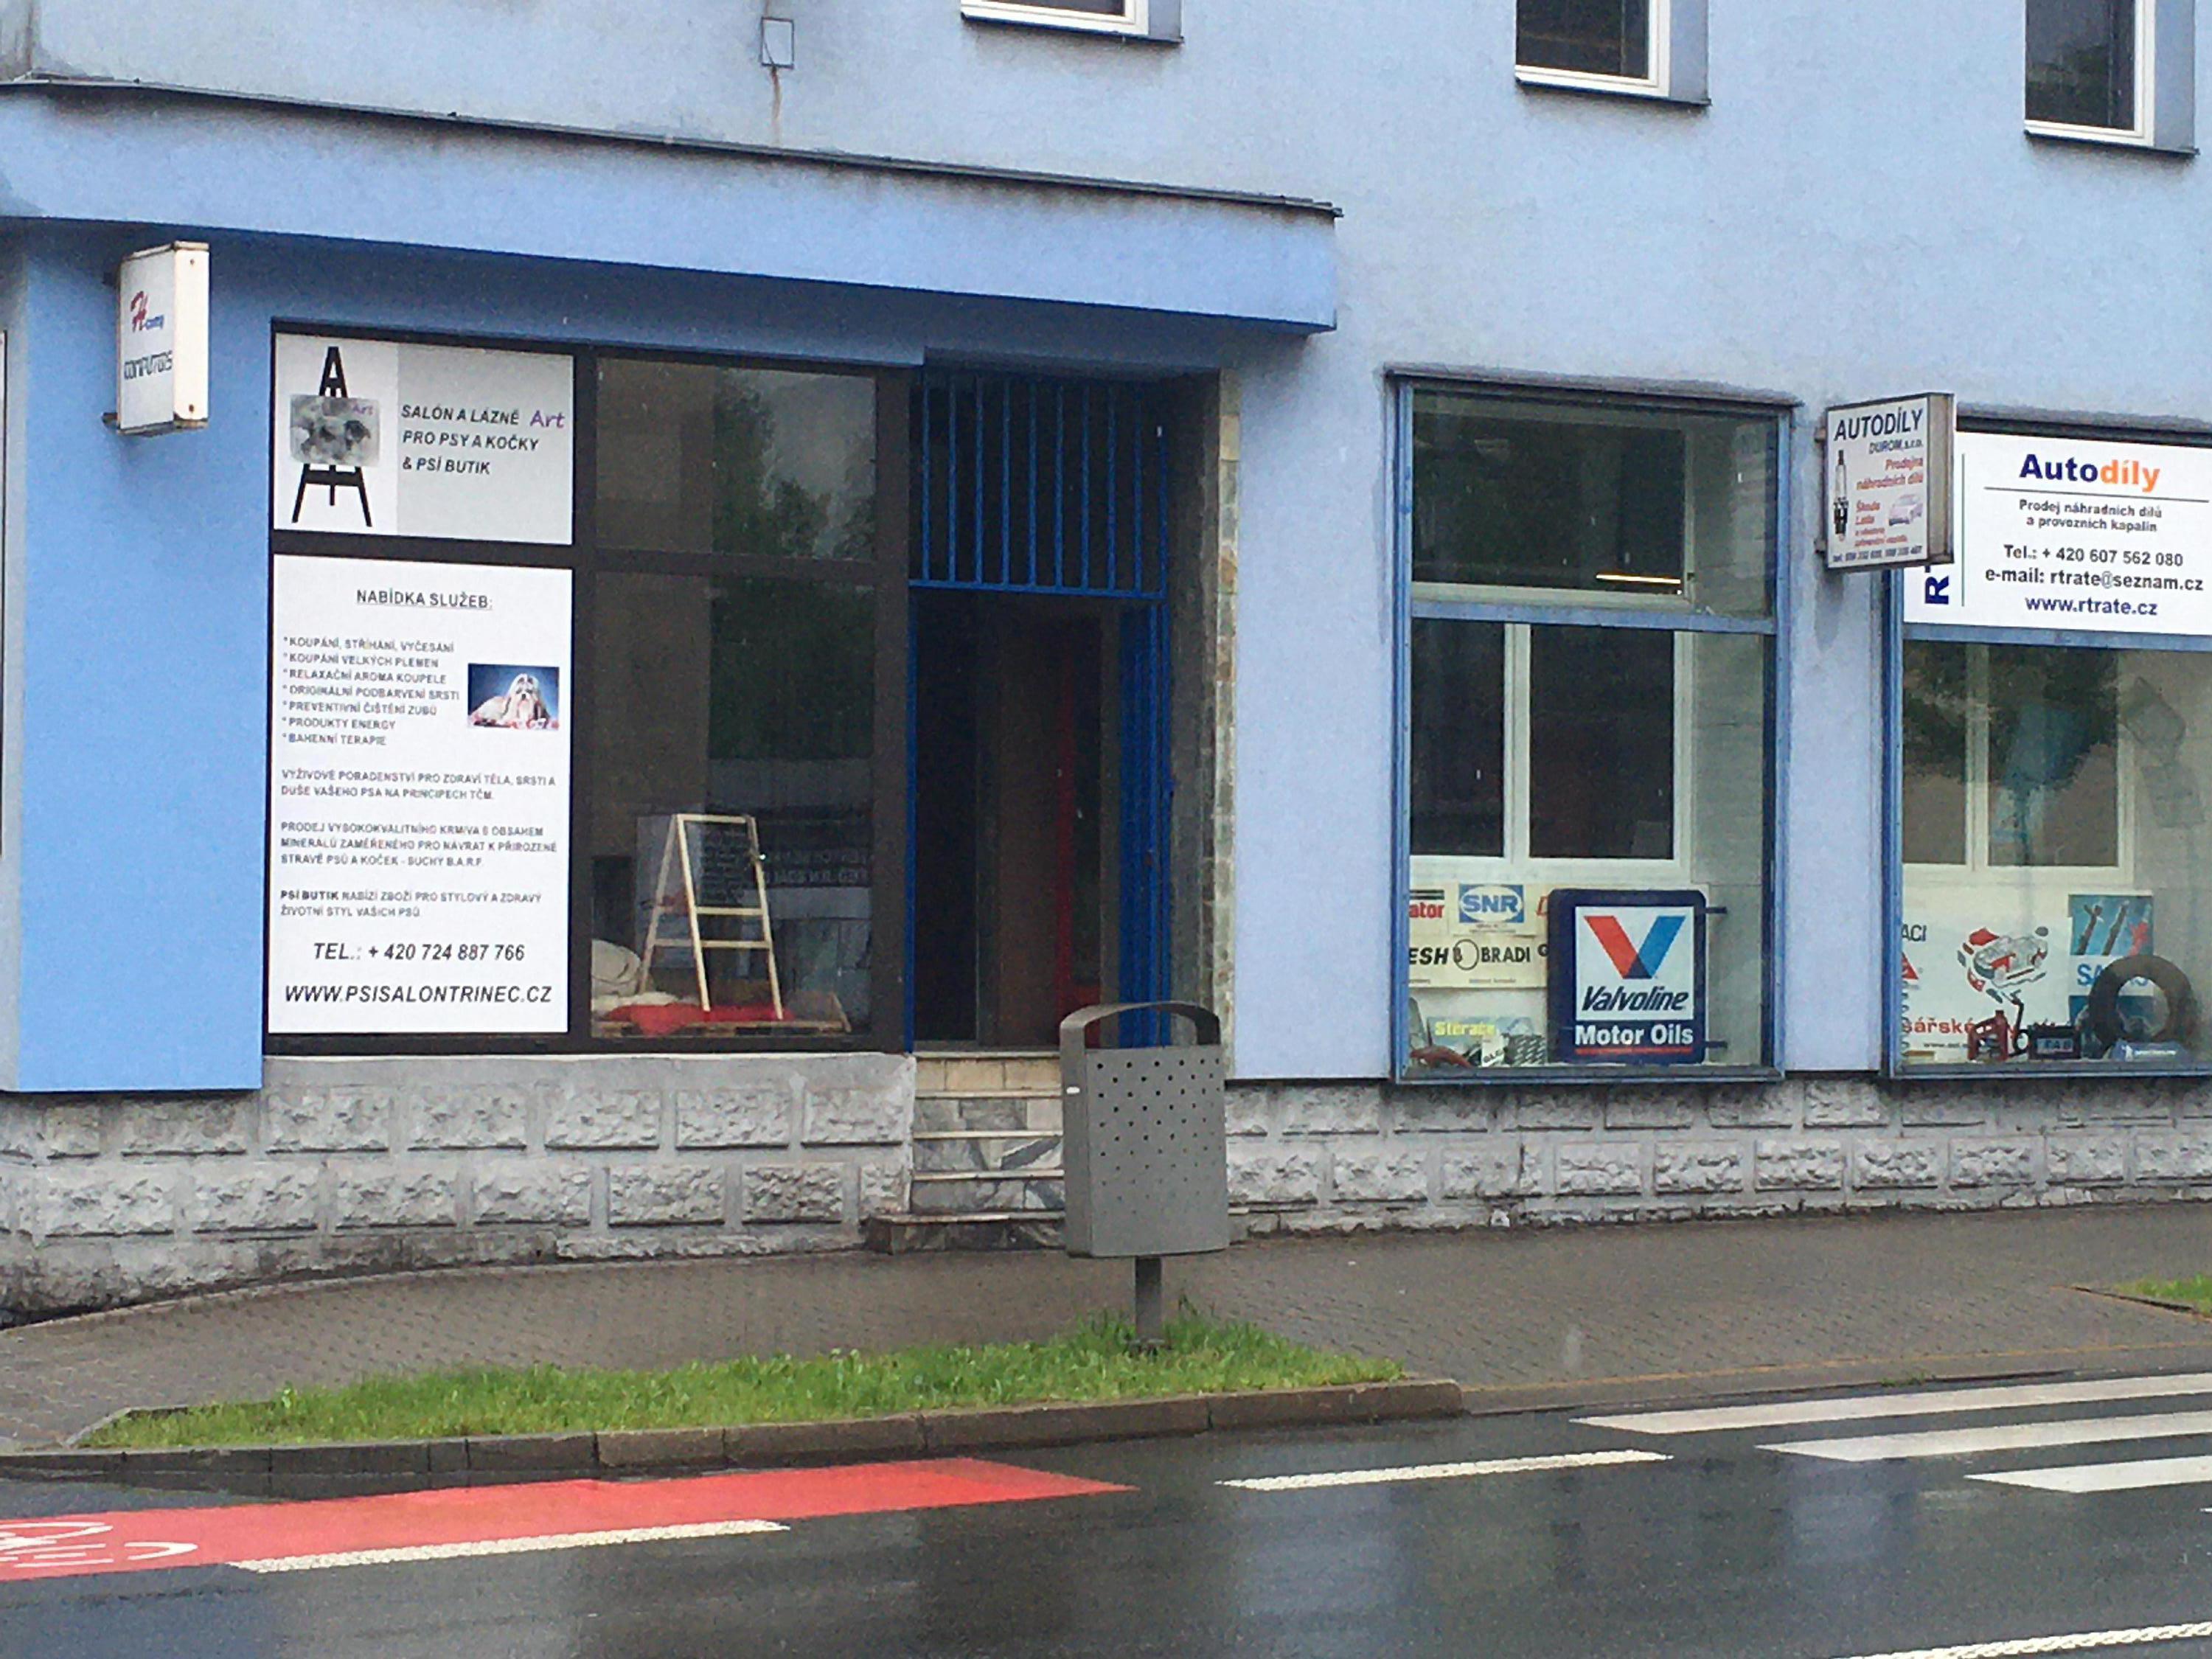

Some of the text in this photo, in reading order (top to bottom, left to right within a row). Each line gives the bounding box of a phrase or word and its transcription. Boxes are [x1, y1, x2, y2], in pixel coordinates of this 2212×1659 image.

[401, 404, 454, 420] SALÓN
[456, 407, 467, 420] A
[529, 410, 566, 428] Art
[1834, 406, 1923, 442] AUTODÍLY
[403, 431, 539, 451] PRO PSY A KOČKY
[403, 456, 490, 476] & PSÍ BUTIK
[2019, 453, 2160, 493] Autodíly
[2020, 498, 2061, 515] Prodej
[2064, 502, 2135, 517] náhradních
[2026, 518, 2157, 533] a provozních kapalin
[2003, 544, 2184, 566] Tel.: + 420 607 562 080
[1985, 568, 2204, 591] e-mail: rtrate@seznam.cz
[357, 588, 493, 609] NABÍDKA SLUŽEB:
[2025, 596, 2157, 616] www.rtrate.cz
[290, 652, 338, 664] KOUPÁNÍ
[395, 658, 439, 667] PLEMEN
[290, 668, 446, 684] RELAXAČNÍ AROMA KOUPELE
[428, 690, 460, 700] SRSTI
[289, 700, 360, 712] PREVENTIVNÍ
[289, 717, 395, 729] PRODUKTY ENERGY
[341, 735, 386, 745] TERAPIE
[417, 773, 439, 782] PRO
[516, 775, 546, 786] SRSTI
[548, 776, 556, 785] A
[281, 784, 310, 796] DUŠE
[314, 784, 357, 797] VAŠEHO
[361, 787, 382, 797] PSA
[385, 787, 399, 797] NA
[281, 821, 324, 832] PRODEJ
[440, 825, 479, 835] KRMIVA
[482, 826, 489, 835] S
[492, 825, 543, 836] OBSAHEM
[418, 840, 440, 850] PRO
[488, 842, 495, 851] K
[327, 853, 348, 864] PSŮ
[350, 855, 358, 864] A
[361, 853, 398, 866] KOČEK
[281, 890, 299, 901] PSÍ
[302, 891, 338, 901] BUTIK
[415, 891, 437, 902] PRO
[490, 892, 498, 902] A
[1461, 894, 1519, 913] SNR
[327, 906, 352, 917] STYL
[369, 947, 378, 957] +
[384, 944, 416, 960] 420
[422, 944, 452, 960] 724
[458, 944, 489, 961] 887
[495, 945, 525, 961] 766
[1481, 947, 1531, 963] BRADI
[285, 984, 552, 1003] WWW.PSISALONTRINEC.CZ
[1581, 986, 1688, 1012] Valvoline
[1575, 1023, 1694, 1046] Motor Oils
